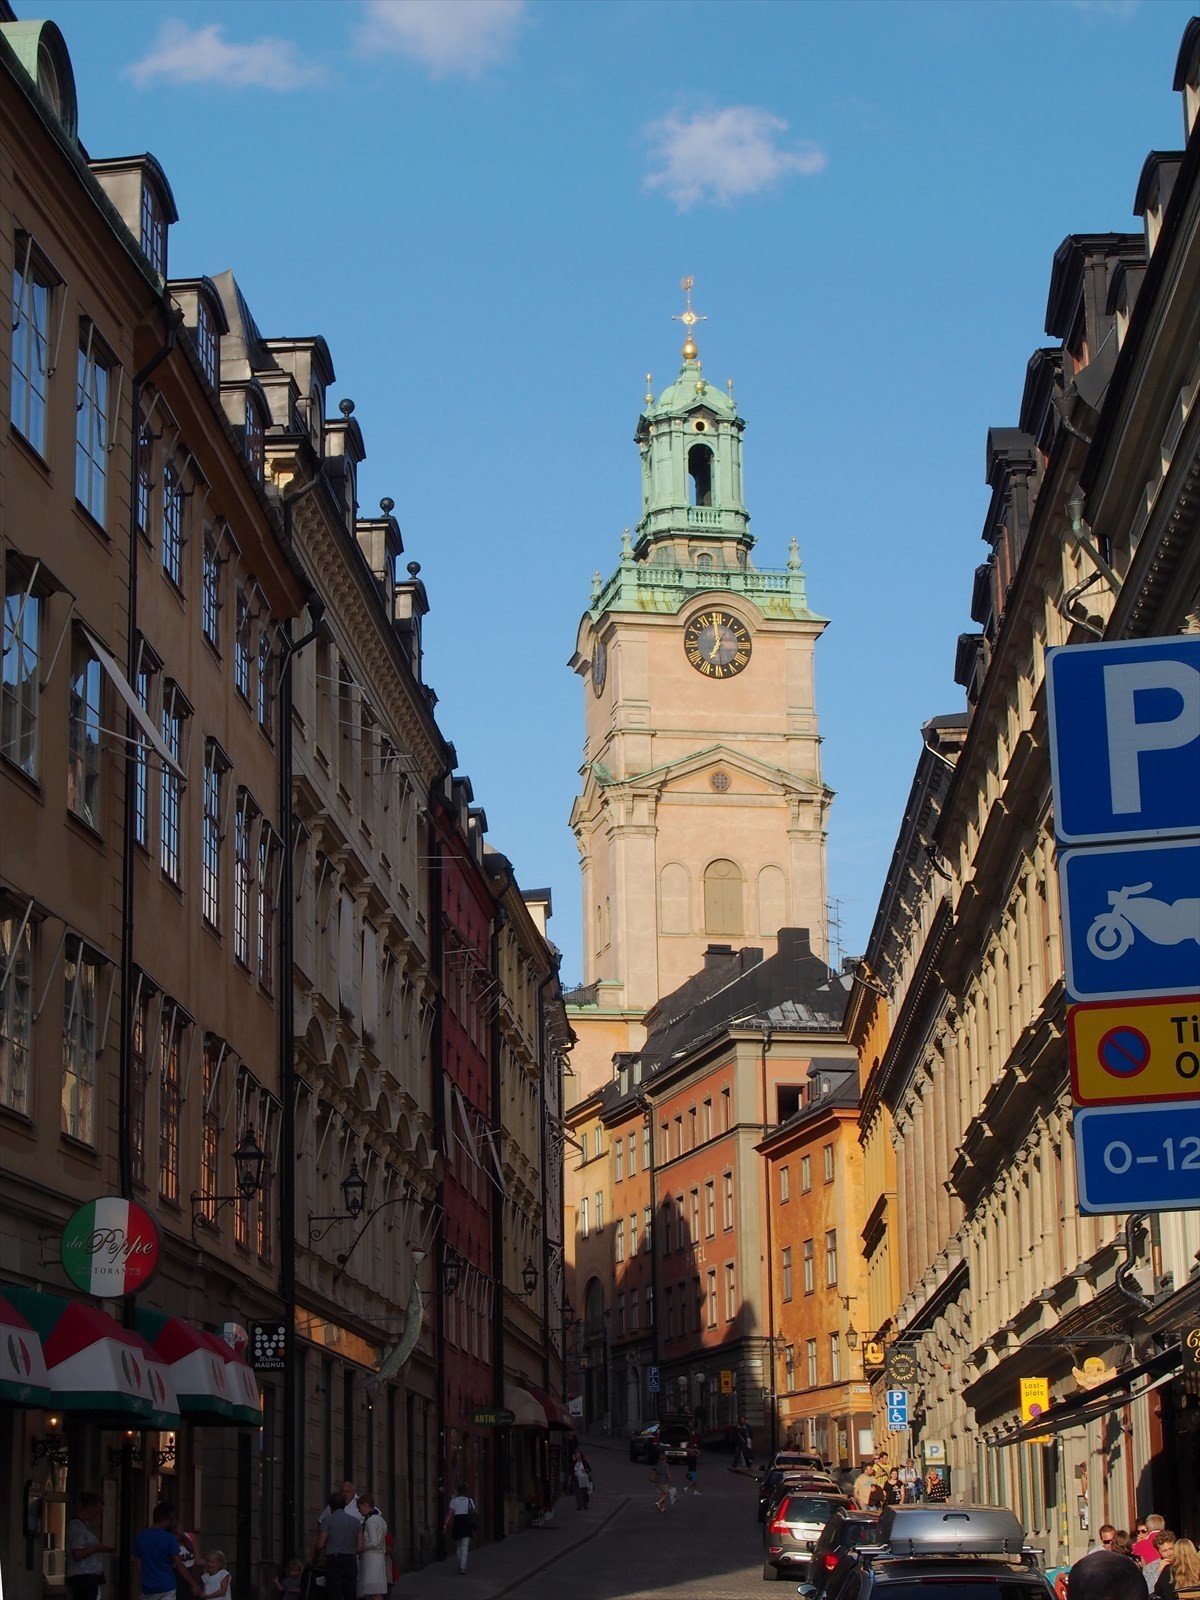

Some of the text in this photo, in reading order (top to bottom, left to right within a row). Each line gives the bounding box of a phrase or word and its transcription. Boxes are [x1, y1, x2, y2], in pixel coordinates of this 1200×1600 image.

[1103, 660, 1200, 814] P
[1171, 1015, 1200, 1043] Ti
[66, 1228, 154, 1264] da Peppe
[652, 1367, 658, 1376] P
[893, 1392, 903, 1406] P
[474, 1414, 496, 1424] ANTIK
[930, 1445, 940, 1457] P
